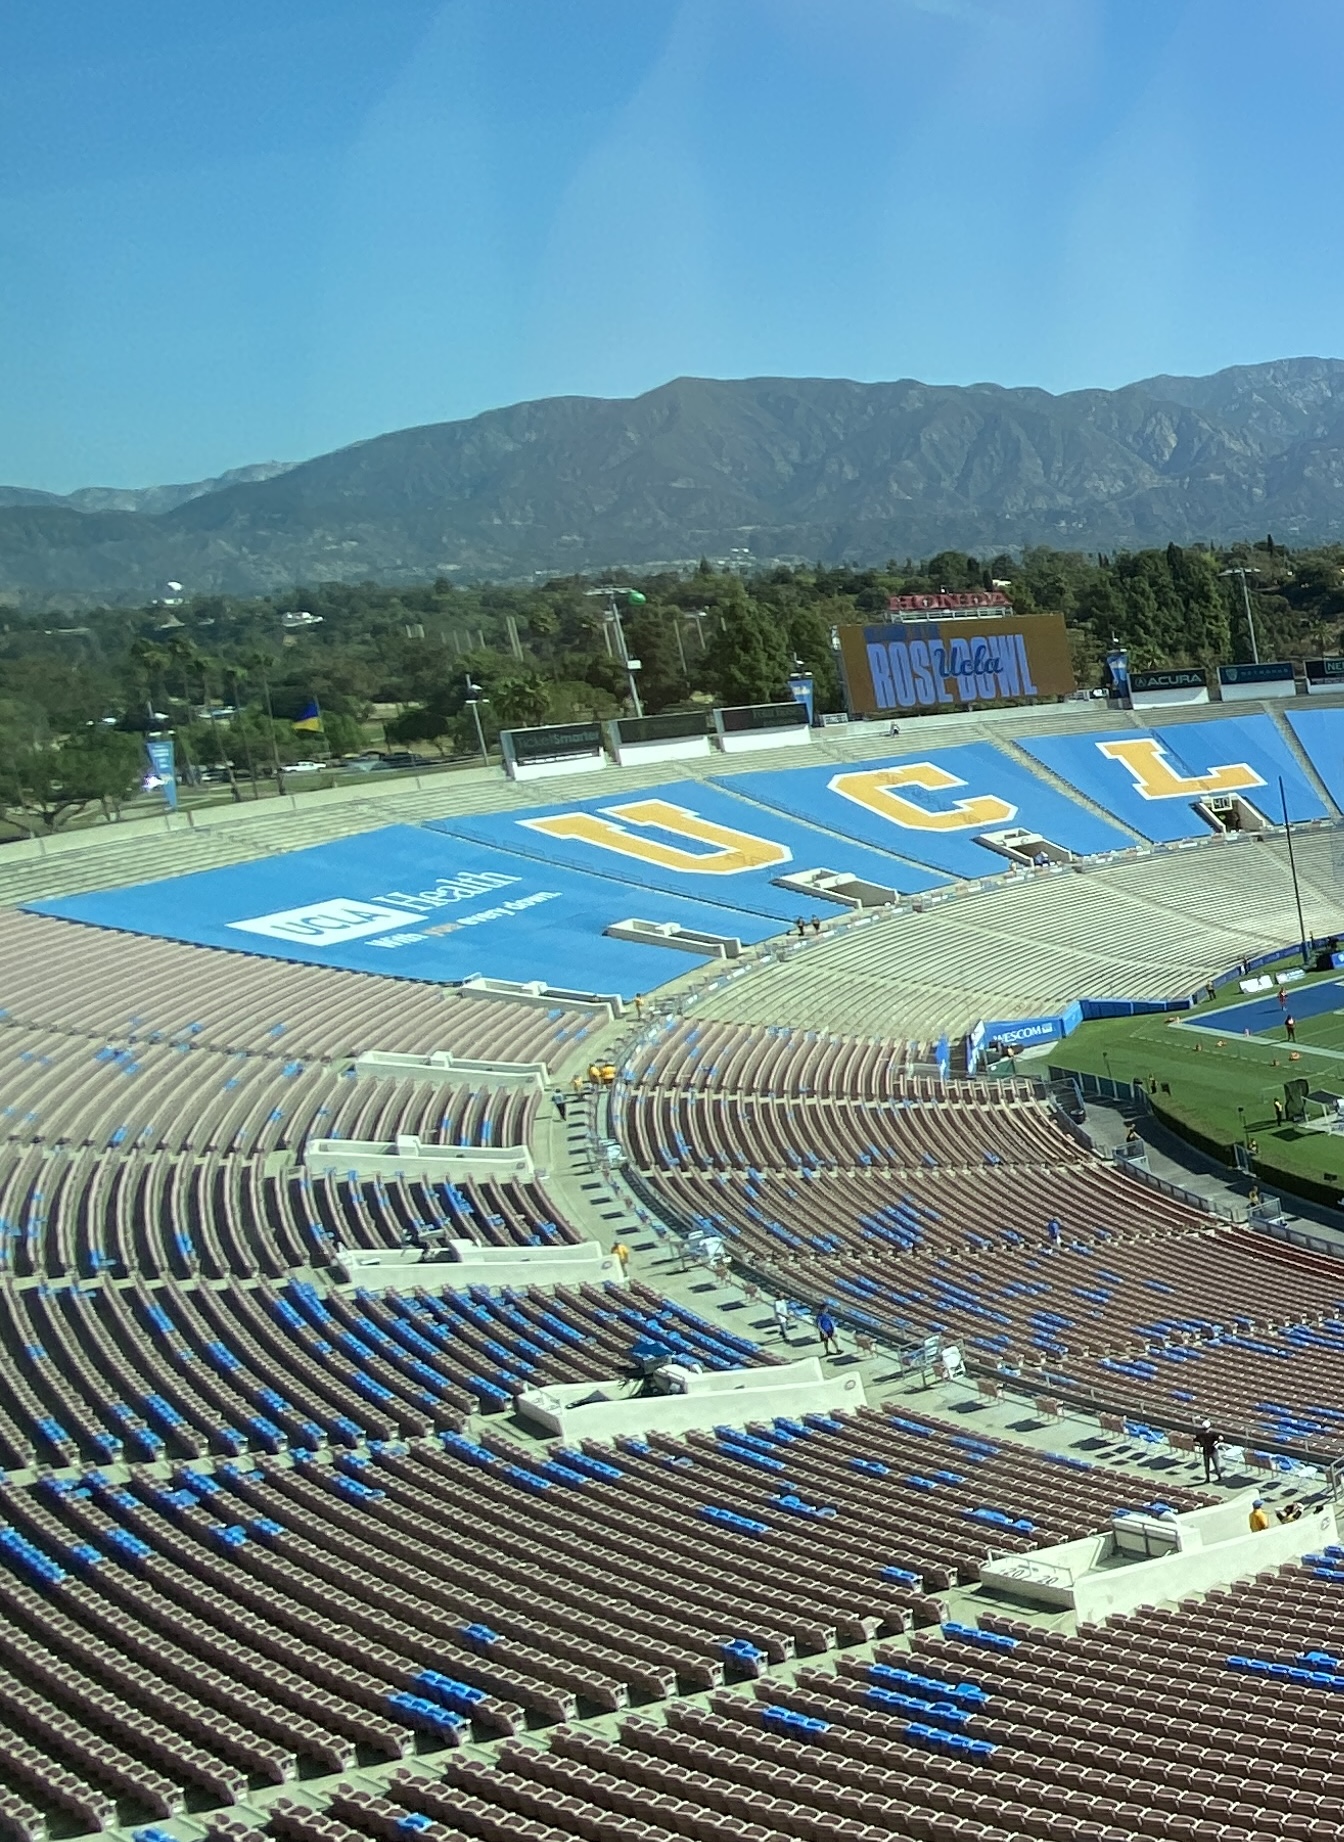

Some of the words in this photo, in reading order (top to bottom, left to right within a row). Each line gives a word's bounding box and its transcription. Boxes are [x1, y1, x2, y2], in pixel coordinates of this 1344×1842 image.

[867, 639, 953, 709] ROSE
[952, 634, 1038, 702] BOWL
[934, 644, 1004, 678] Ucla
[1148, 672, 1203, 687] ACURA
[270, 907, 392, 936] UCLA
[370, 870, 523, 913] Health
[365, 931, 429, 948] With
[457, 905, 516, 928] every
[993, 1025, 1041, 1042] WESCOM
